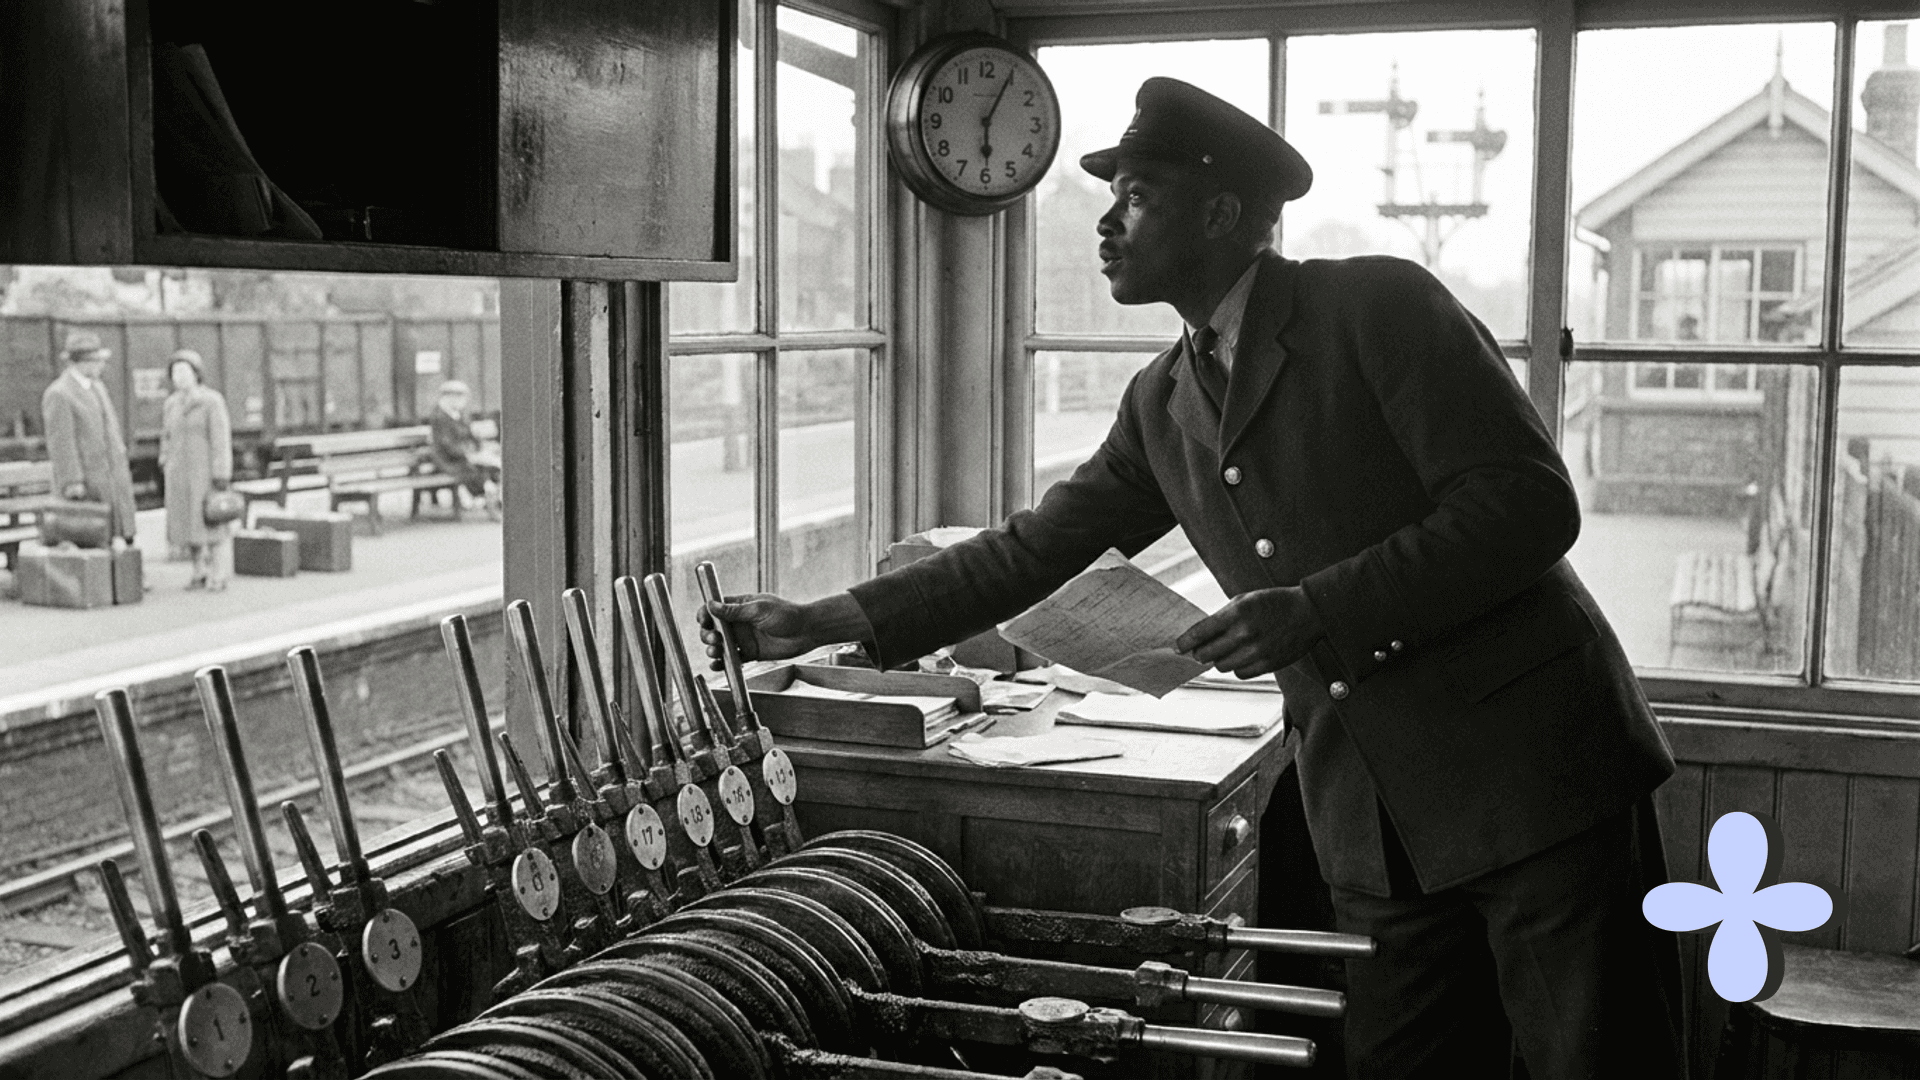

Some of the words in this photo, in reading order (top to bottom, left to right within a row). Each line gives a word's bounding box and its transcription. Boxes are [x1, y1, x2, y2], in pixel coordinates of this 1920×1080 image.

[958, 67, 969, 85] 11
[979, 61, 996, 79] 12
[938, 86, 954, 104] 10
[1023, 90, 1036, 107] 2
[930, 113, 942, 130] 9
[1029, 117, 1042, 134] 3
[938, 140, 950, 157] 8
[1021, 143, 1034, 159] 4
[956, 159, 968, 177] 7
[980, 168, 992, 184] 6
[1005, 161, 1017, 178] 5
[641, 825, 654, 846] 17
[388, 938, 401, 960] 3
[306, 973, 321, 998] 2
[213, 1017, 224, 1041] 1
